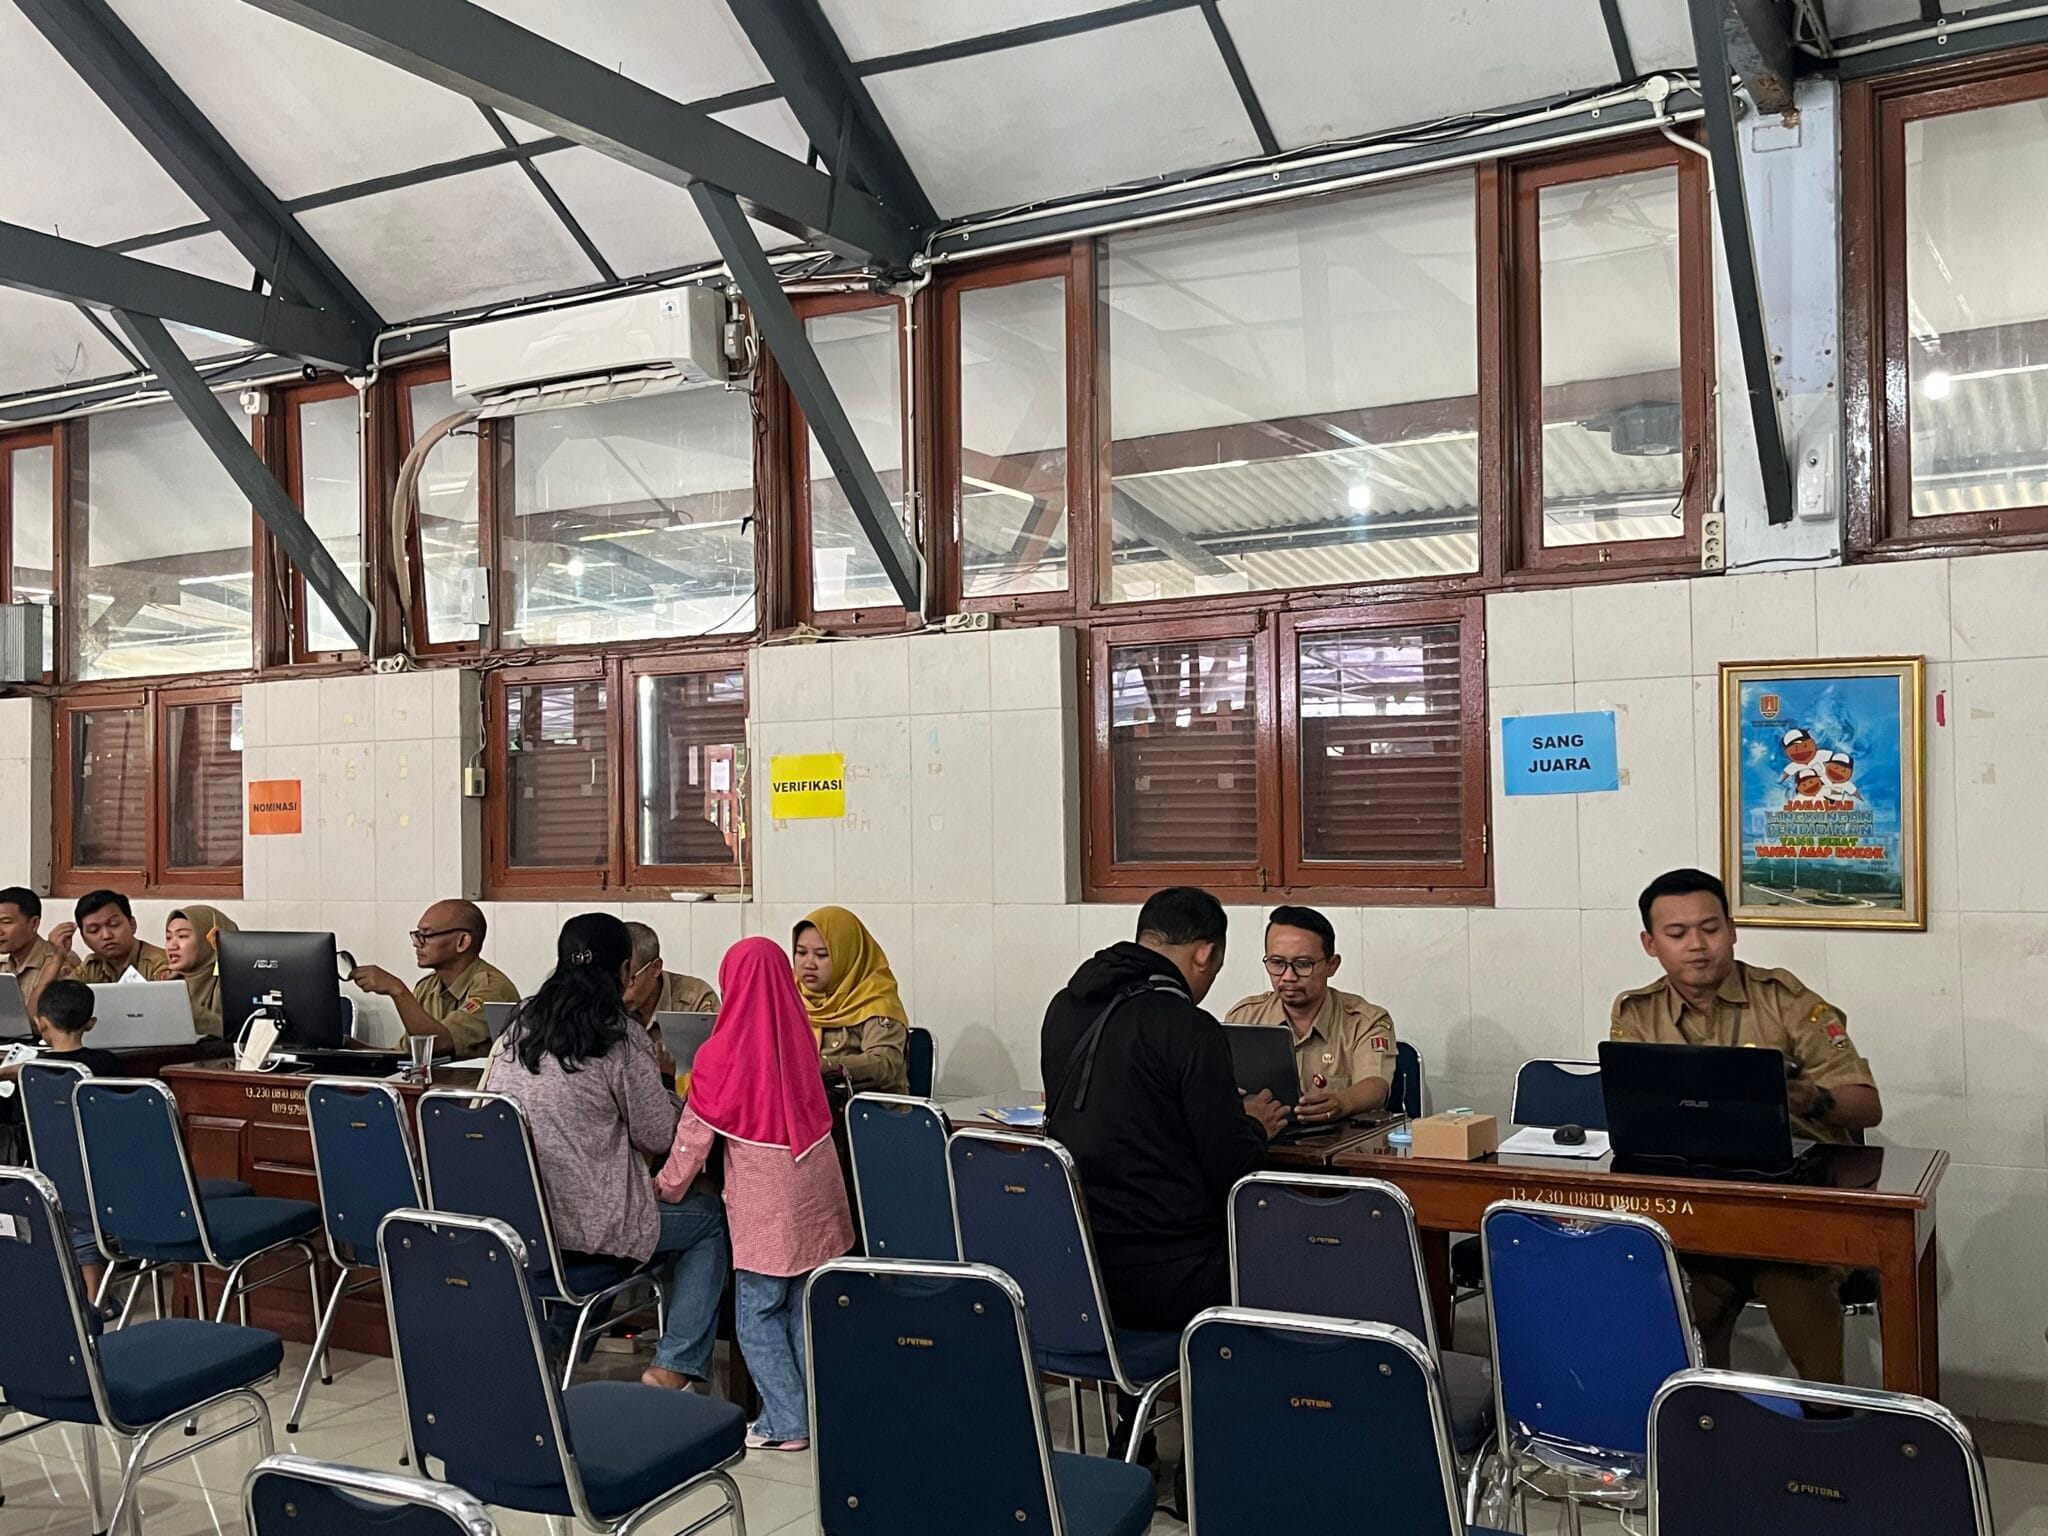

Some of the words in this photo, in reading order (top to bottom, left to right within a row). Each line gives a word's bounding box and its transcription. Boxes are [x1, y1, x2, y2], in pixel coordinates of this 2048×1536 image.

[1532, 734, 1584, 750] SANG
[1528, 757, 1591, 773] JUARA
[773, 780, 842, 793] VERIFIKASI
[253, 802, 297, 812] NOMINASI
[1681, 1200, 1694, 1215] A
